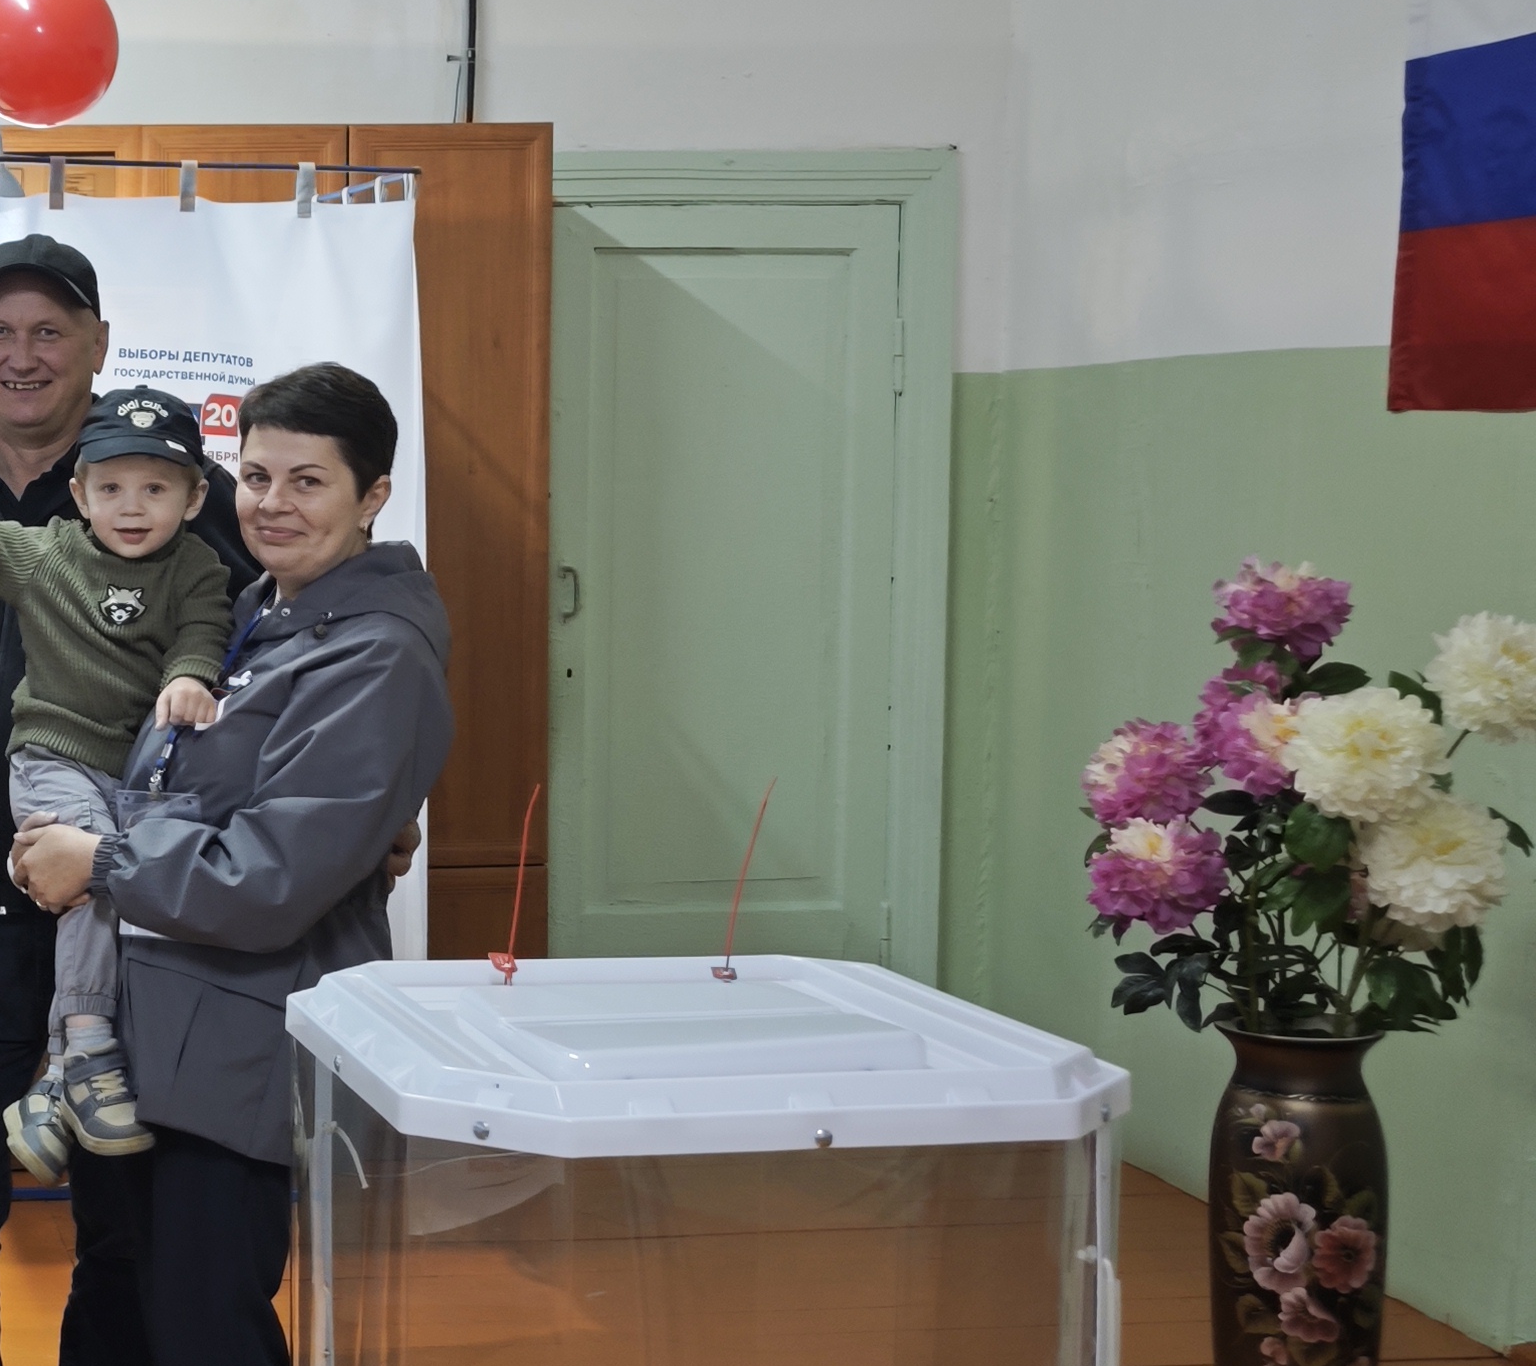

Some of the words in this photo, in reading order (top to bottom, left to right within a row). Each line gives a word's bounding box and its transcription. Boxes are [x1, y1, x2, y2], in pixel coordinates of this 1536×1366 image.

[118, 348, 179, 361] ВЫБОРЫ
[183, 351, 253, 367] ДЕПУТАТОВ
[114, 368, 226, 382] ГОСУДАРСТВЕННОЙ
[228, 375, 256, 386] ДУМЫ
[204, 402, 237, 428] 20
[204, 450, 238, 463] ЯБРЯ
